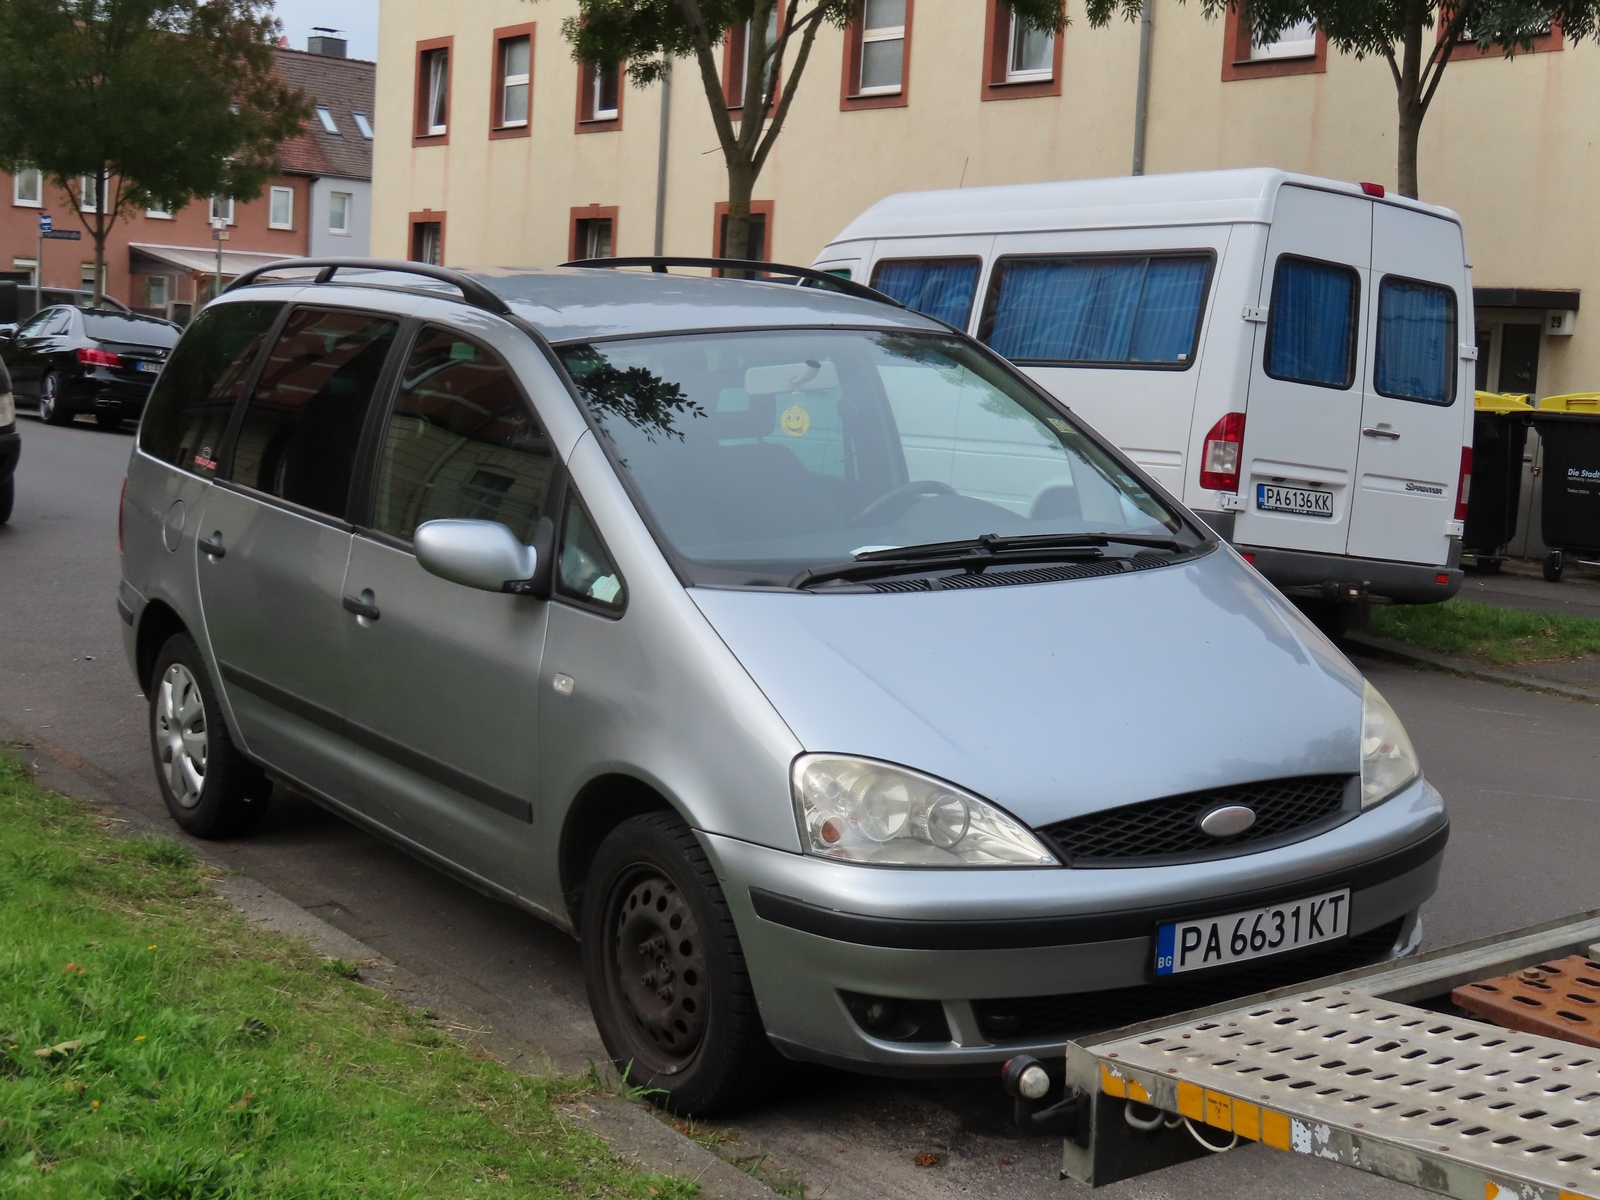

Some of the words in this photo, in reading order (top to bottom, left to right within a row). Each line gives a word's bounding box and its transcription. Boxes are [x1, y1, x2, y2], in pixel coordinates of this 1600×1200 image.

[1551, 316, 1562, 328] 29
[1567, 468, 1580, 477] Die
[1581, 469, 1600, 478] Stadt
[1158, 955, 1173, 969] BG
